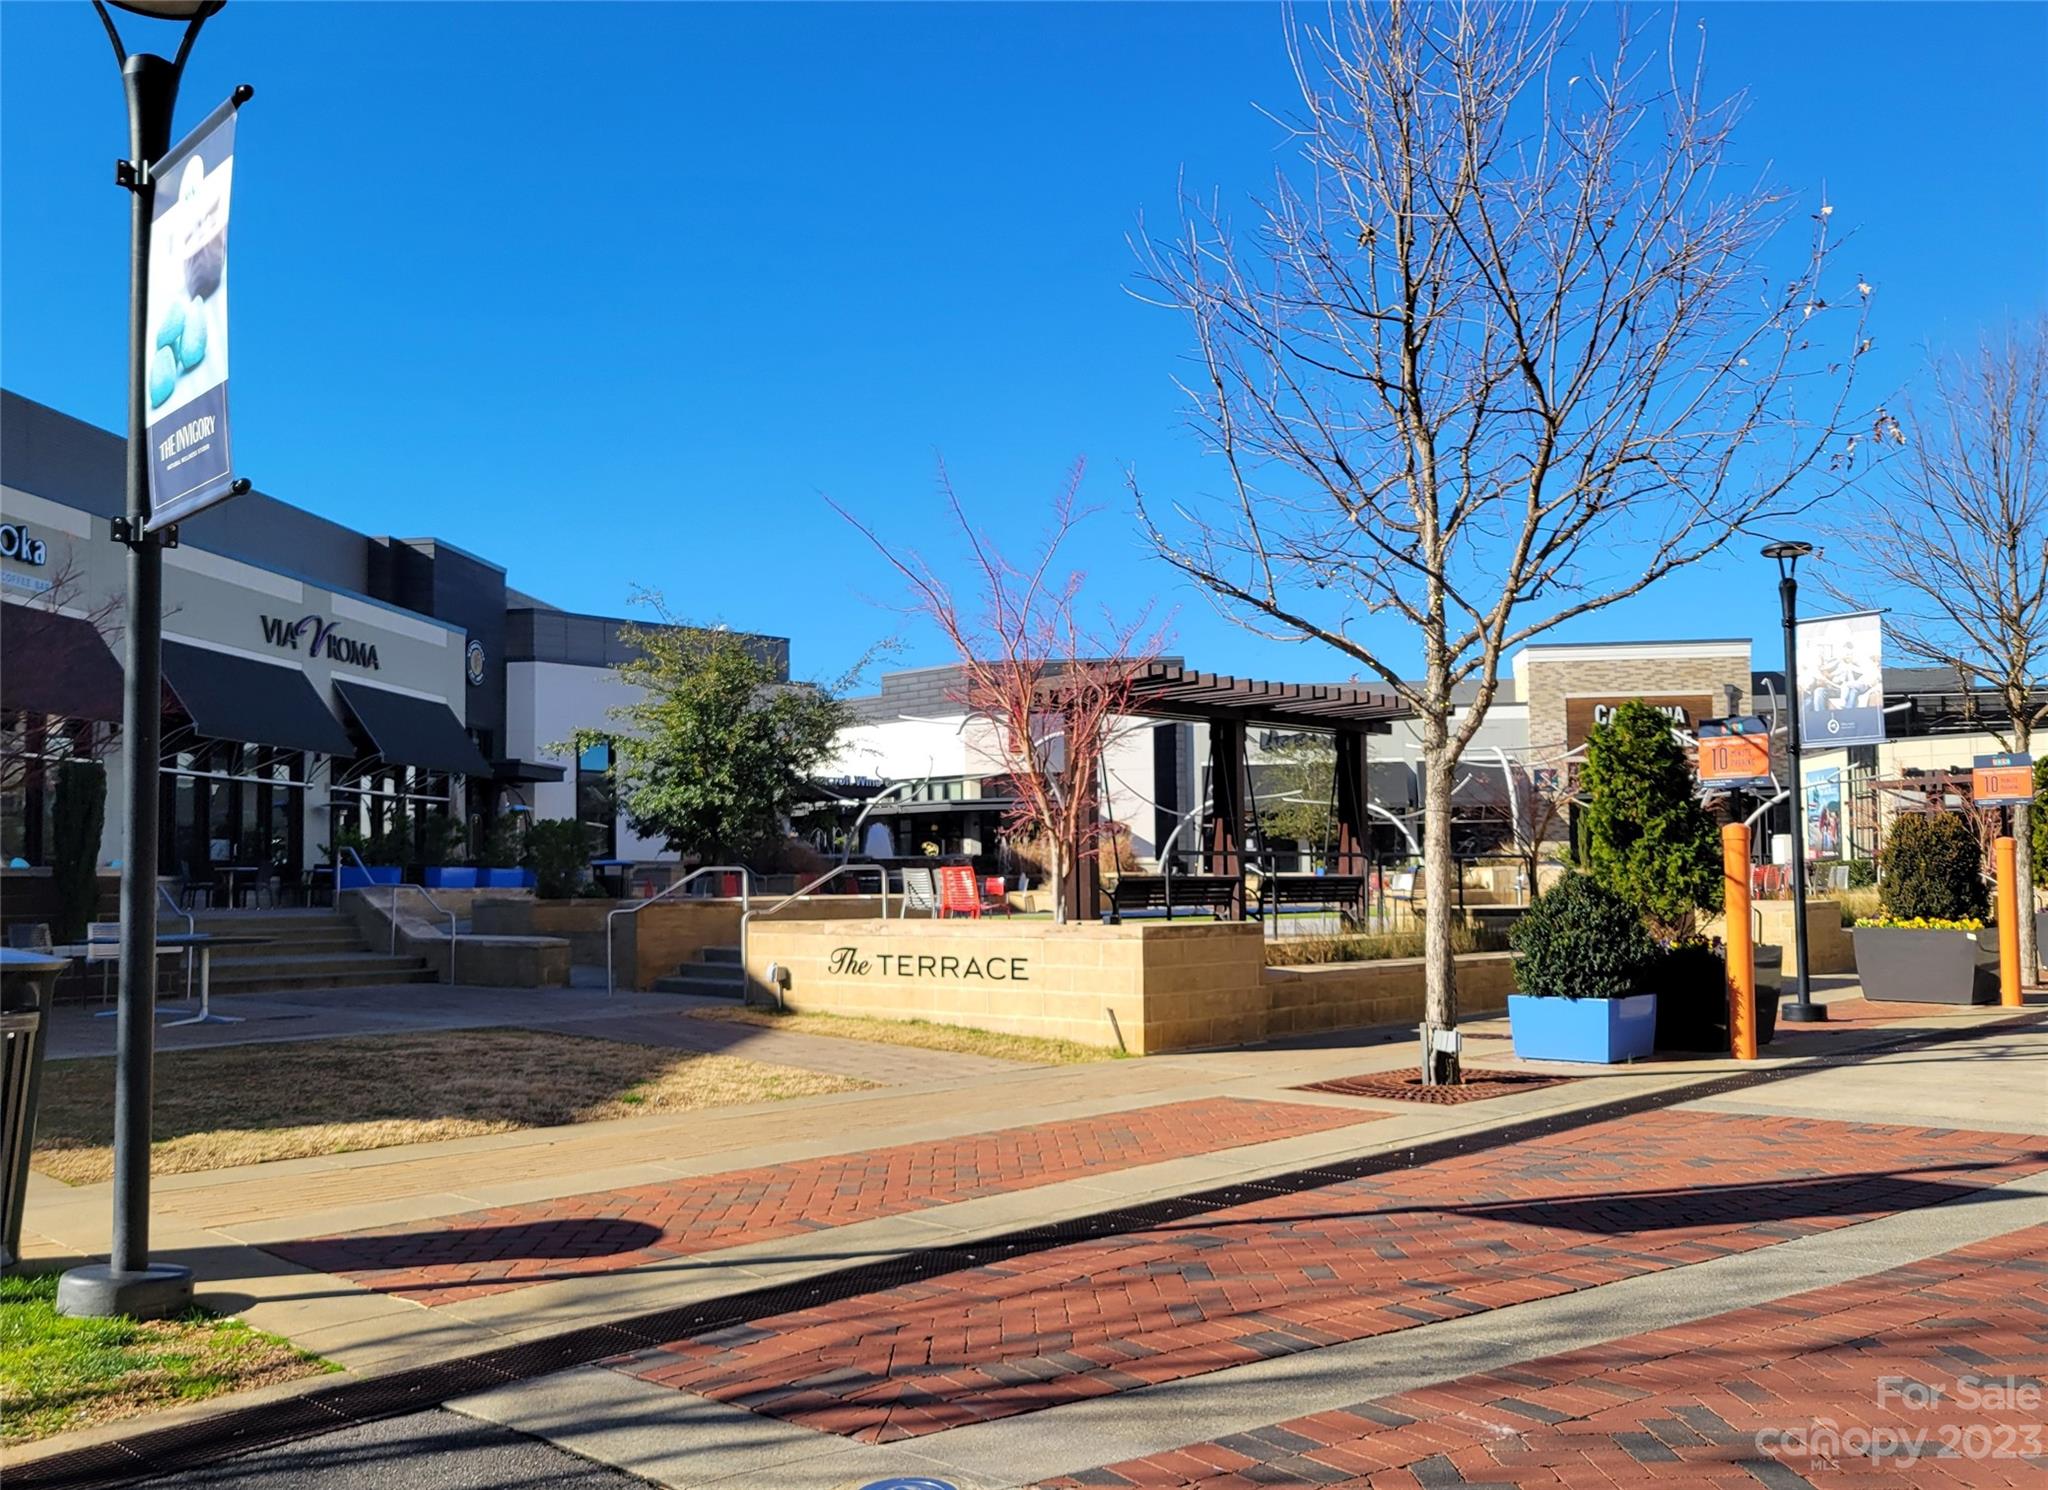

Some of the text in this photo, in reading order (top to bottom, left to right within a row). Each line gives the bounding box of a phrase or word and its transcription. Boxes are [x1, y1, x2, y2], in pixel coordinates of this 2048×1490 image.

[159, 434, 176, 461] THE
[176, 416, 216, 453] INVIGORY
[260, 615, 297, 650] VIA
[326, 634, 380, 670] ROMA
[1712, 747, 1728, 771] 10
[1984, 775, 1999, 793] 10
[827, 946, 1030, 981] The TERRACE
